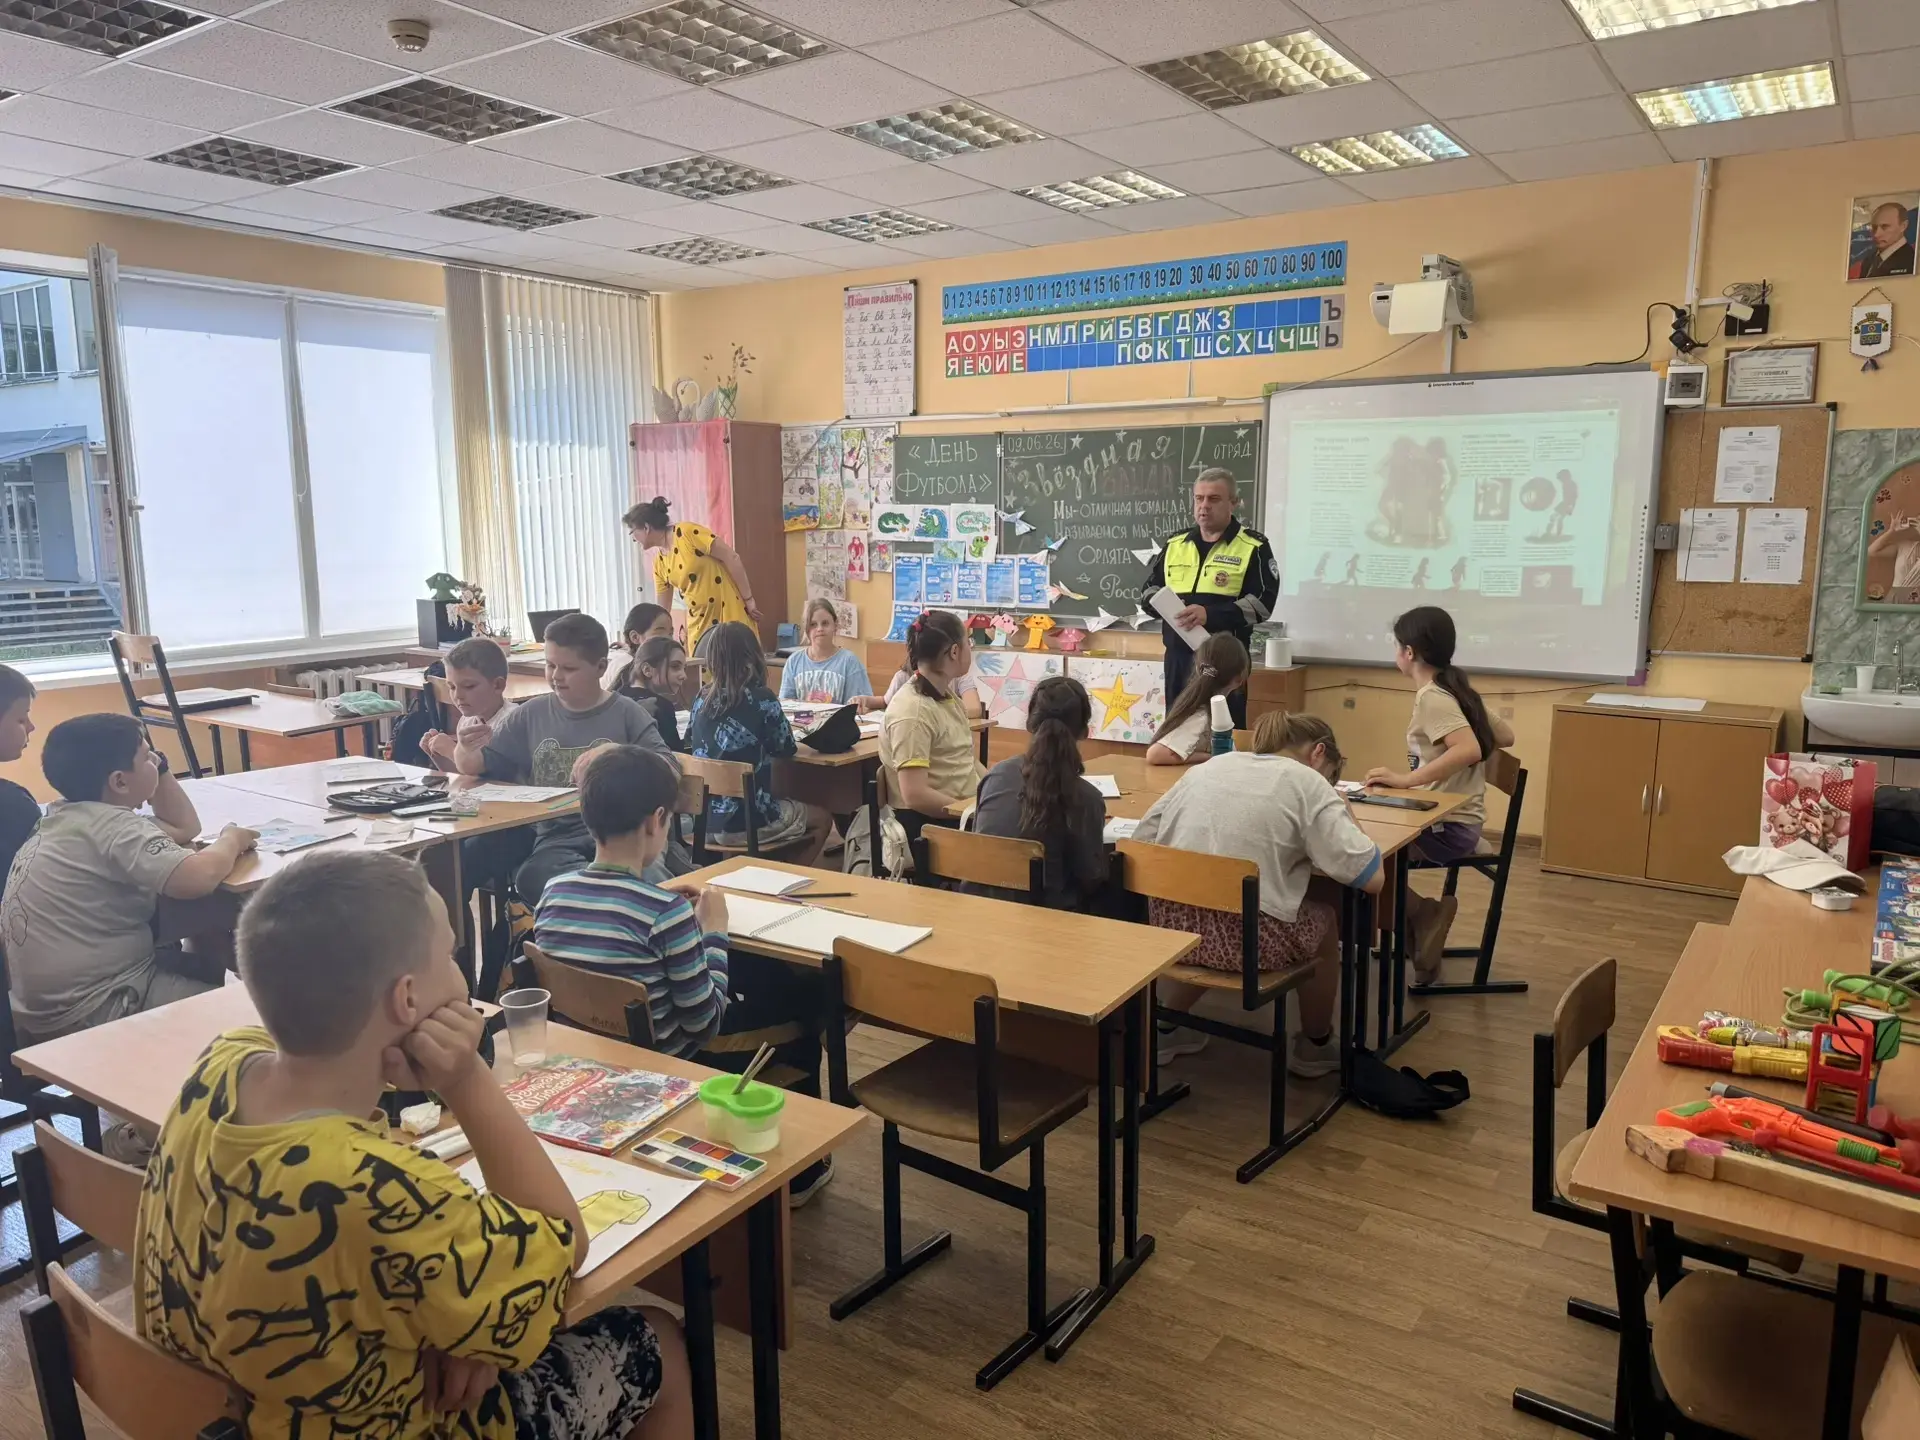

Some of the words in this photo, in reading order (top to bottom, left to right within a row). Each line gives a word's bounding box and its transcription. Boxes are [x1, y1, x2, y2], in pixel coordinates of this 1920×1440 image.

[1024, 284, 1033, 301] 10
[1037, 283, 1046, 300] 11
[1051, 281, 1061, 298] 12
[1065, 280, 1075, 297] 13
[1080, 278, 1090, 295] 14
[1095, 276, 1105, 294] 15
[1109, 275, 1119, 292] 16
[1124, 273, 1135, 291] 17
[1139, 271, 1150, 289] 18
[1155, 269, 1166, 287] 19
[1170, 267, 1181, 286] 20
[1190, 265, 1202, 284] 30
[1208, 263, 1221, 281] 40
[1226, 260, 1239, 280] 50
[1245, 259, 1258, 278] 60
[1264, 256, 1276, 275] 70
[1282, 254, 1295, 274] 80
[1302, 252, 1315, 272] 90
[1321, 249, 1342, 269] 100
[1188, 427, 1208, 476] 4
[1213, 441, 1252, 460] ОТРЯД
